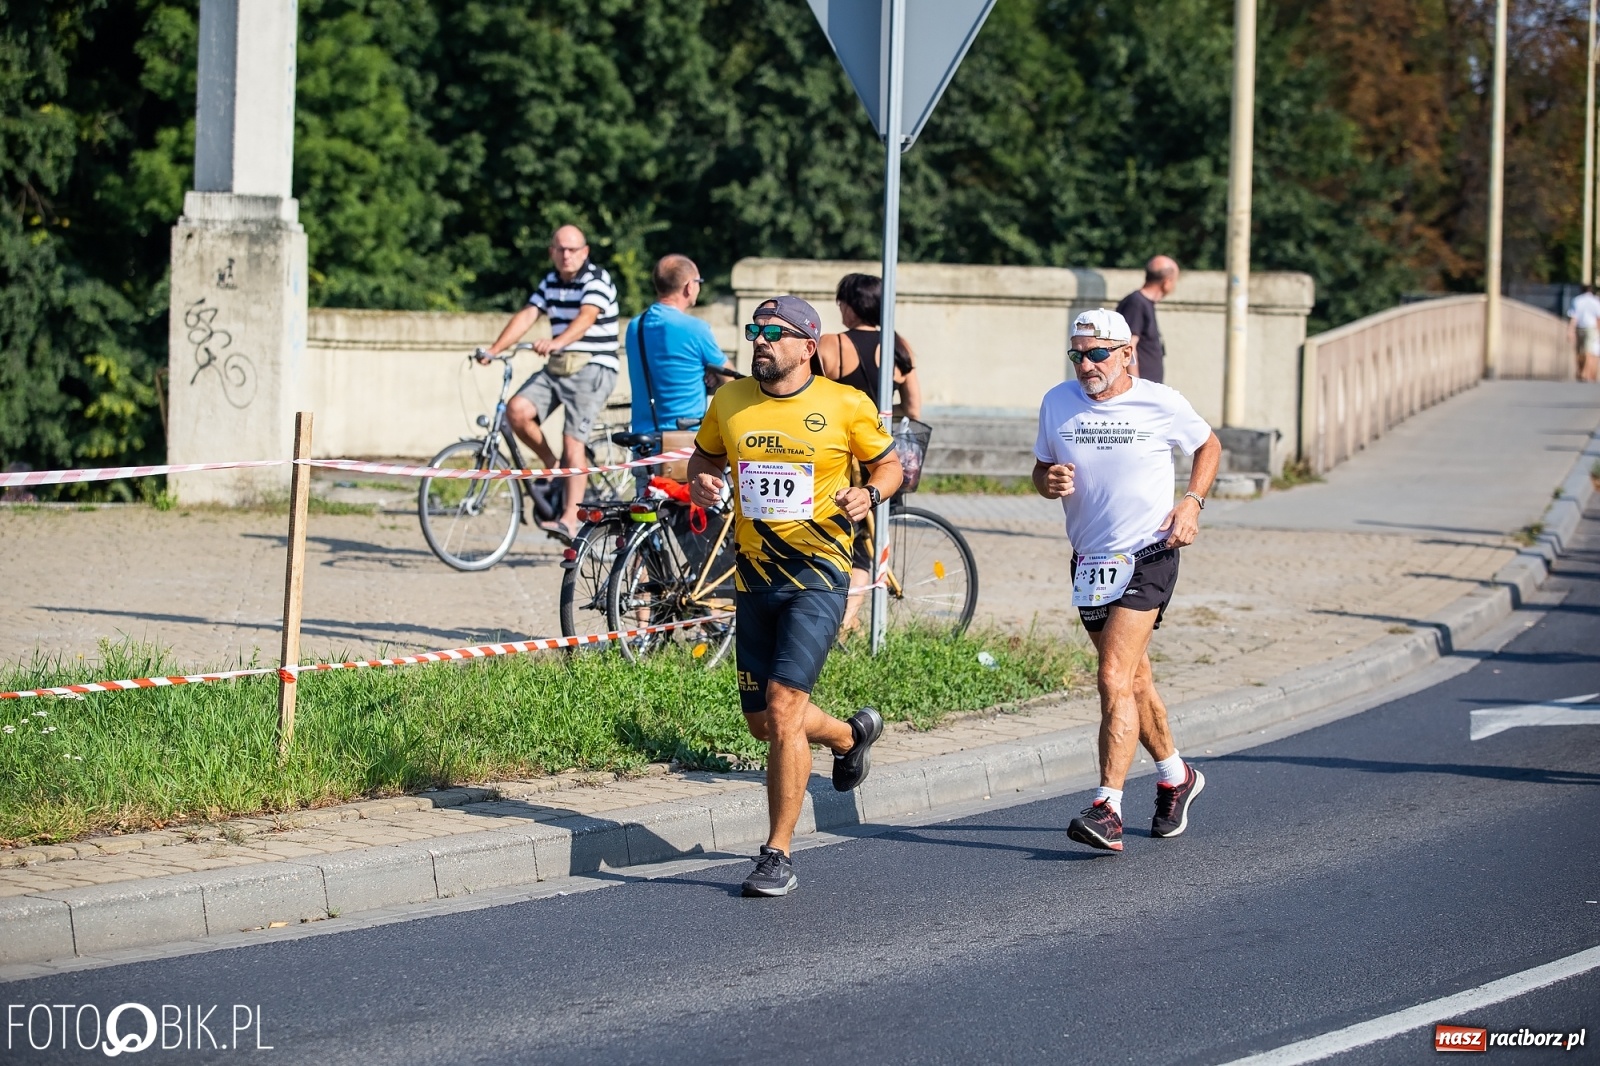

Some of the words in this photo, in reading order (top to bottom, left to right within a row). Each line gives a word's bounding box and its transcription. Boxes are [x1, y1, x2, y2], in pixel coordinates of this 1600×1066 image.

[745, 436, 783, 448] OPEL
[1075, 436, 1096, 444] PIKNIK
[1097, 436, 1134, 444] WOJSKOWY
[759, 477, 795, 498] 319
[1088, 567, 1117, 585] 317
